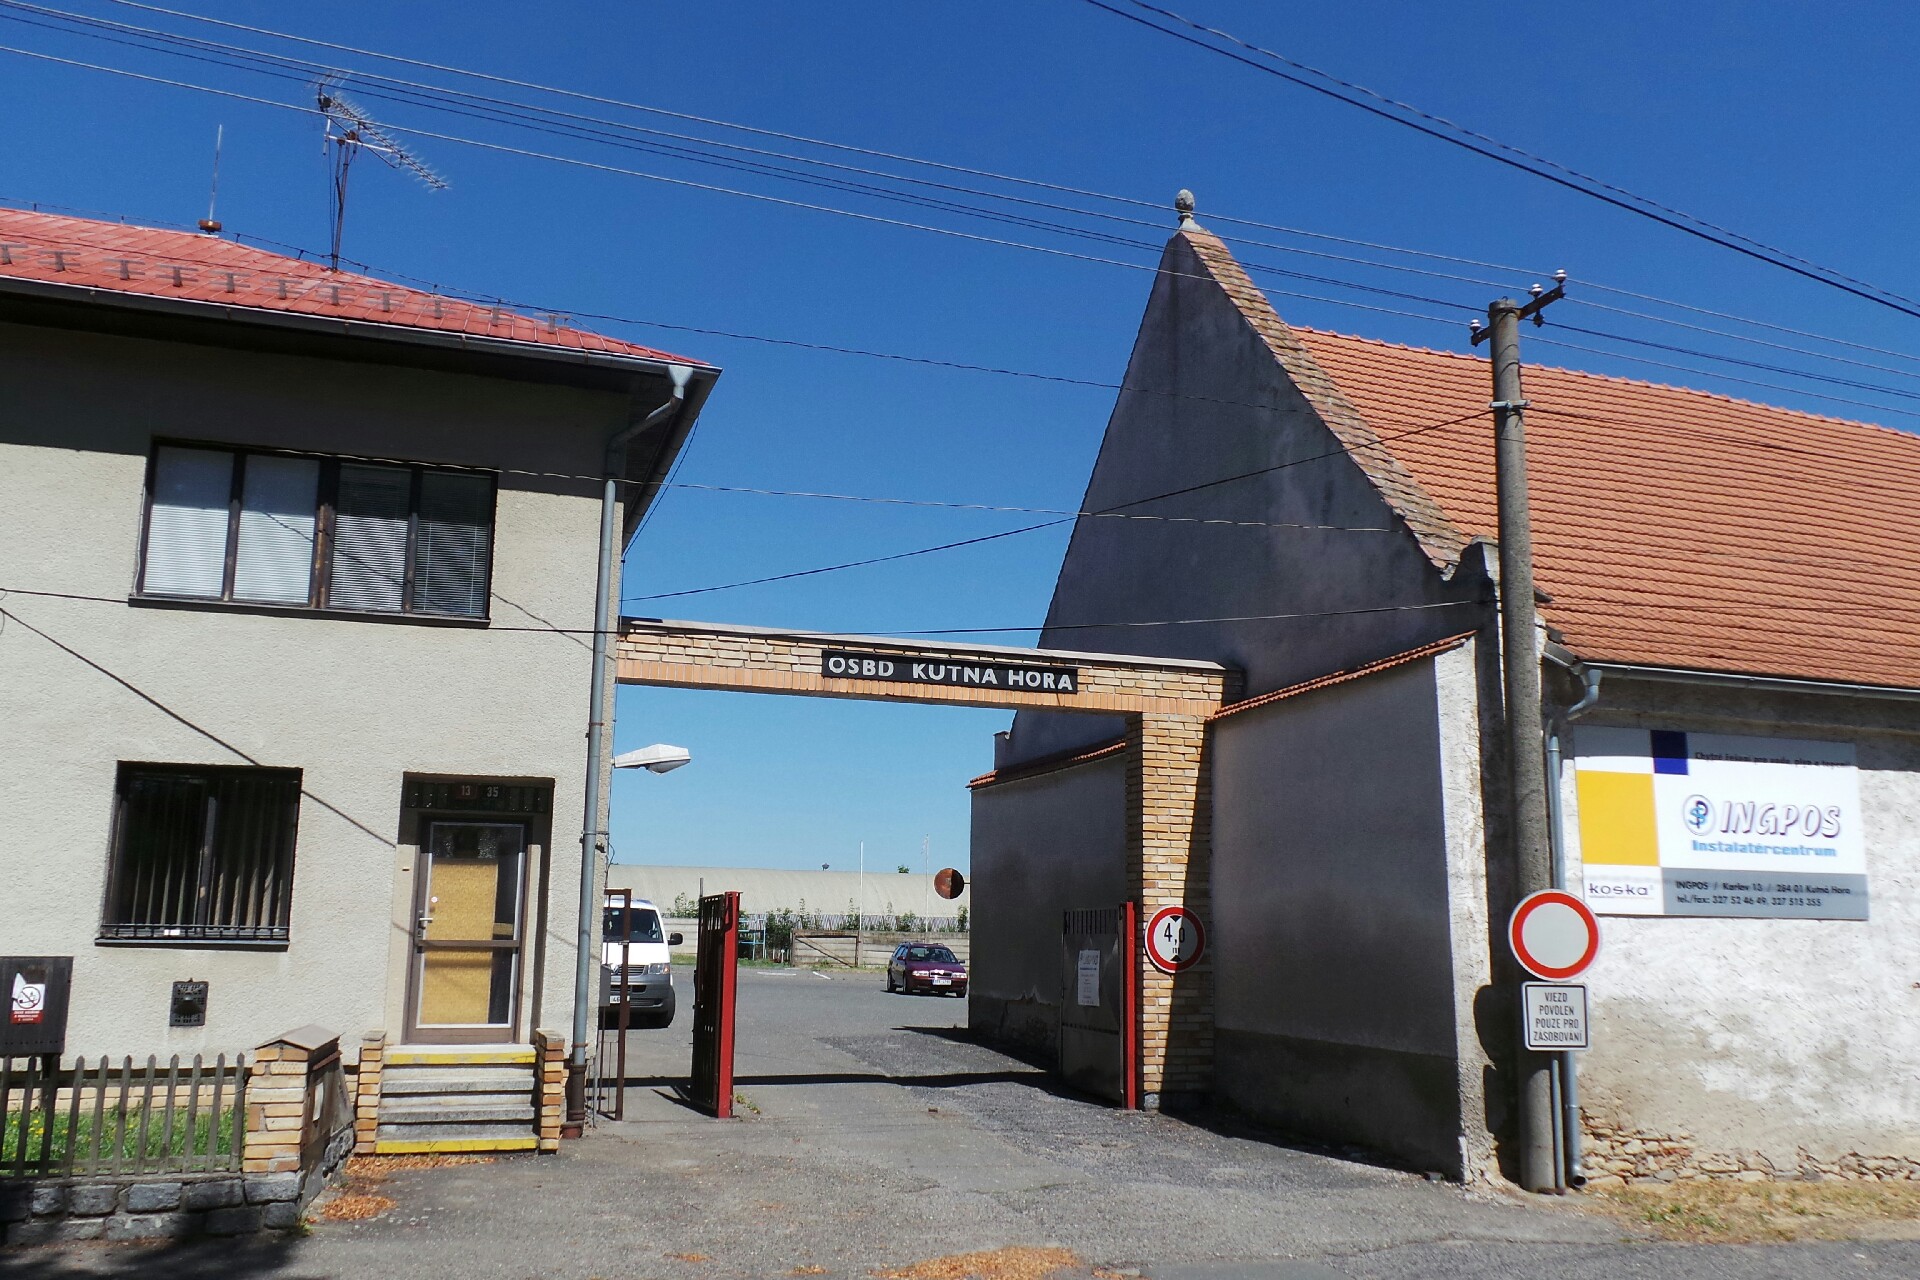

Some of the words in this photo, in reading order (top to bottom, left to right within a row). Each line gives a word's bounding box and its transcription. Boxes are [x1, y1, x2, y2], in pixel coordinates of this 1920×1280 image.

[828, 656, 894, 677] OSBD
[912, 663, 998, 685] KUTNA
[1008, 669, 1073, 690] HORA
[487, 785, 499, 798] 35
[1720, 801, 1841, 838] INGPOS
[1692, 840, 1837, 856] Instalatércentrum
[1589, 883, 1649, 896] koska
[1676, 881, 1709, 890] INGPOS
[1752, 883, 1763, 891] 13
[1831, 886, 1850, 894] Hora
[1712, 896, 1728, 904] 327
[1772, 897, 1787, 905] 327
[1164, 922, 1185, 945] 4,0
[1545, 992, 1568, 1002] VJEZD
[1539, 1005, 1575, 1016] POVOLEN
[1535, 1018, 1561, 1029] POUZE
[1563, 1018, 1579, 1029] PRO
